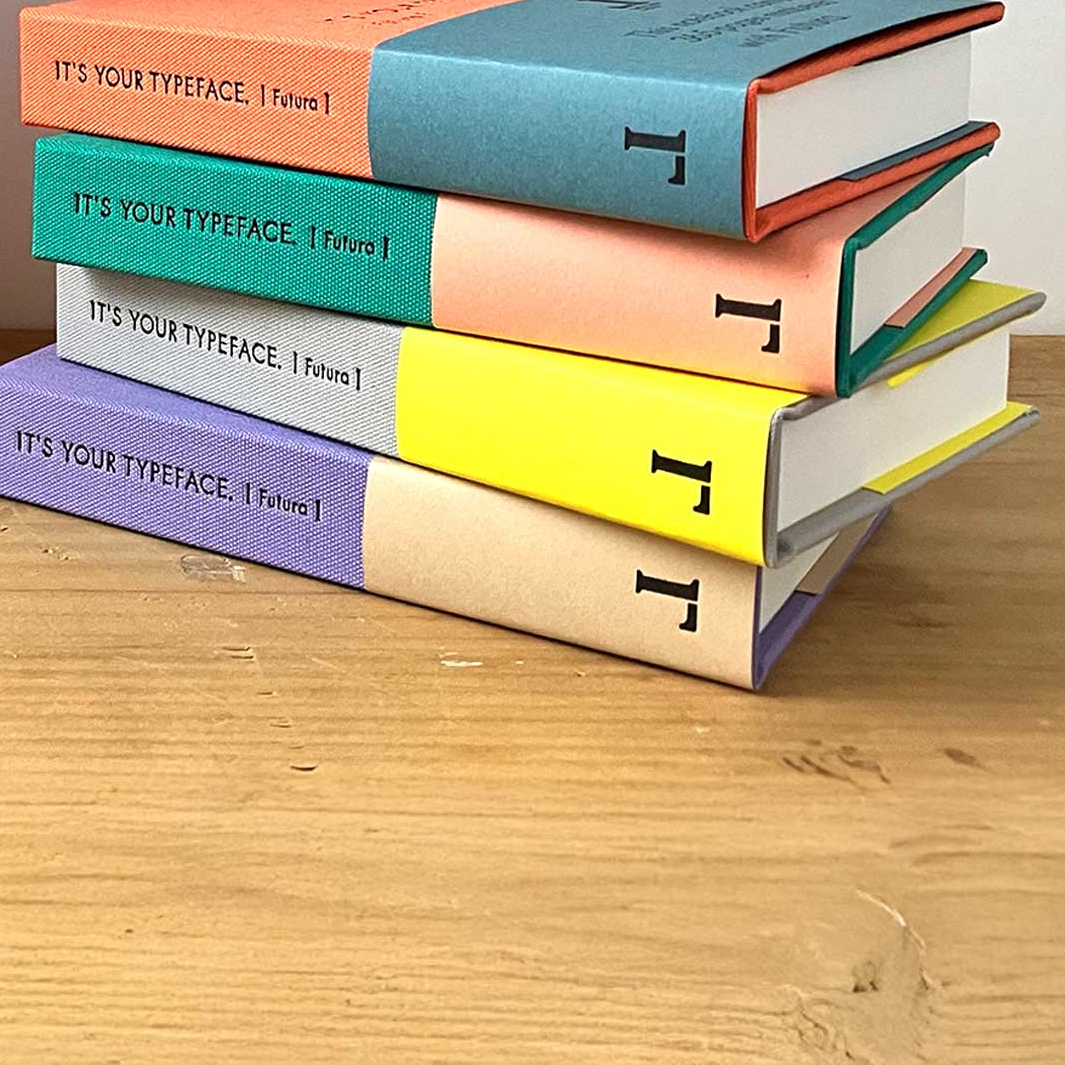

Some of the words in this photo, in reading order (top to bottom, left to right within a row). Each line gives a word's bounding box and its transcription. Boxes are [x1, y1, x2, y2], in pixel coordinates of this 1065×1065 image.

[55, 61, 87, 83] IT'S
[94, 64, 143, 91] YOUR
[149, 70, 249, 105] TYPEFACE.
[73, 192, 111, 218] IT'S
[119, 198, 176, 228] YOUR
[184, 208, 297, 245] TYPEFACE.
[89, 300, 122, 326] IT'S
[128, 309, 177, 342] YOUR
[183, 323, 282, 369] TYPEFACE.
[16, 430, 53, 457] IT'S
[61, 440, 116, 473] YOUR
[122, 454, 233, 502] TYPEFACE.
